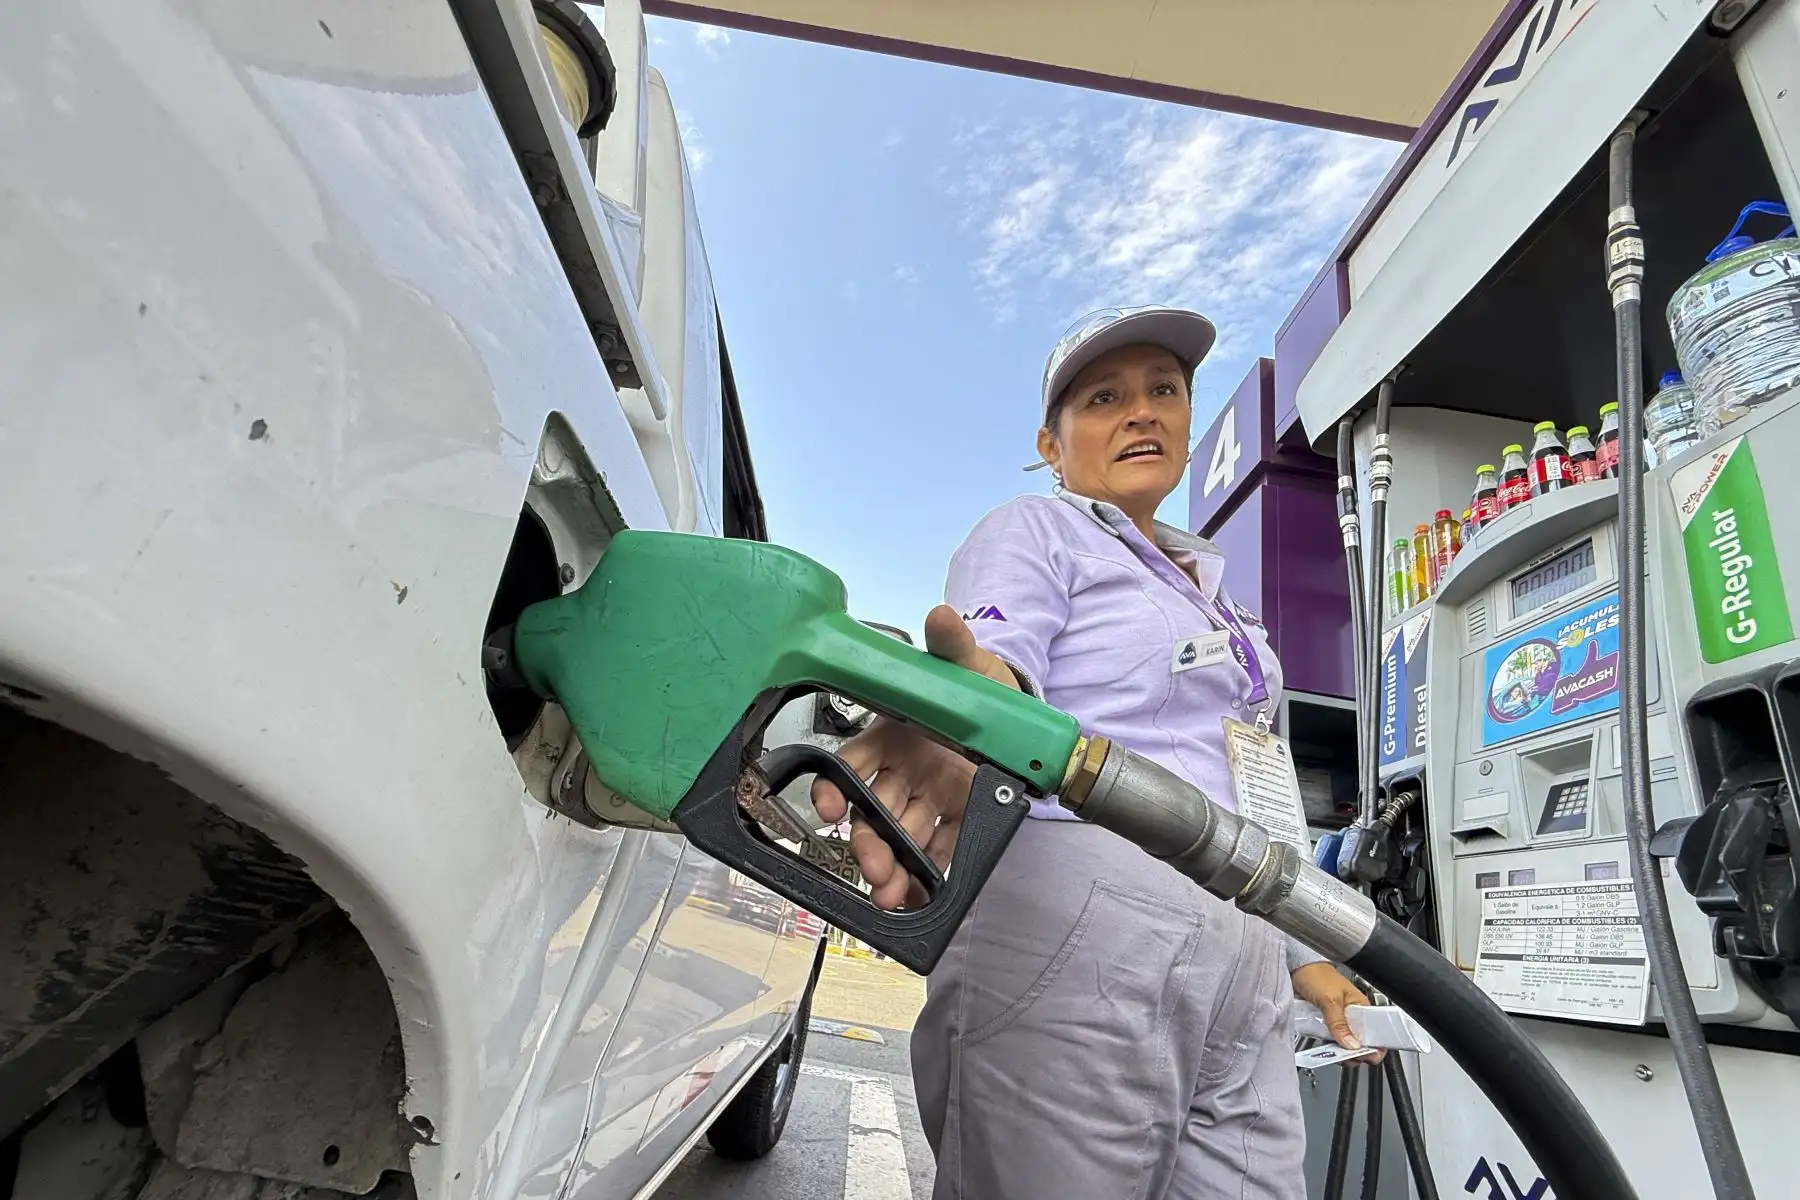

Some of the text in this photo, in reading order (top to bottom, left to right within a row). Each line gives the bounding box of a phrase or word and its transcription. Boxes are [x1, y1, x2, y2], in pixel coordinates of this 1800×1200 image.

[1203, 406, 1241, 498] 4
[1709, 507, 1758, 644] G-Regular
[963, 605, 1007, 621] VA
[1558, 604, 1619, 638] ¡ACUMUL
[1180, 651, 1196, 660] AVA
[1206, 645, 1225, 656] KARIN
[1555, 667, 1613, 699] AVACASH
[1384, 654, 1397, 756] G-Premium
[1414, 684, 1428, 748] Diesel
[1576, 884, 1629, 894] COMBUSTIBLES
[1572, 917, 1626, 925] COMBUSTIBLES
[1627, 917, 1637, 925] (2)
